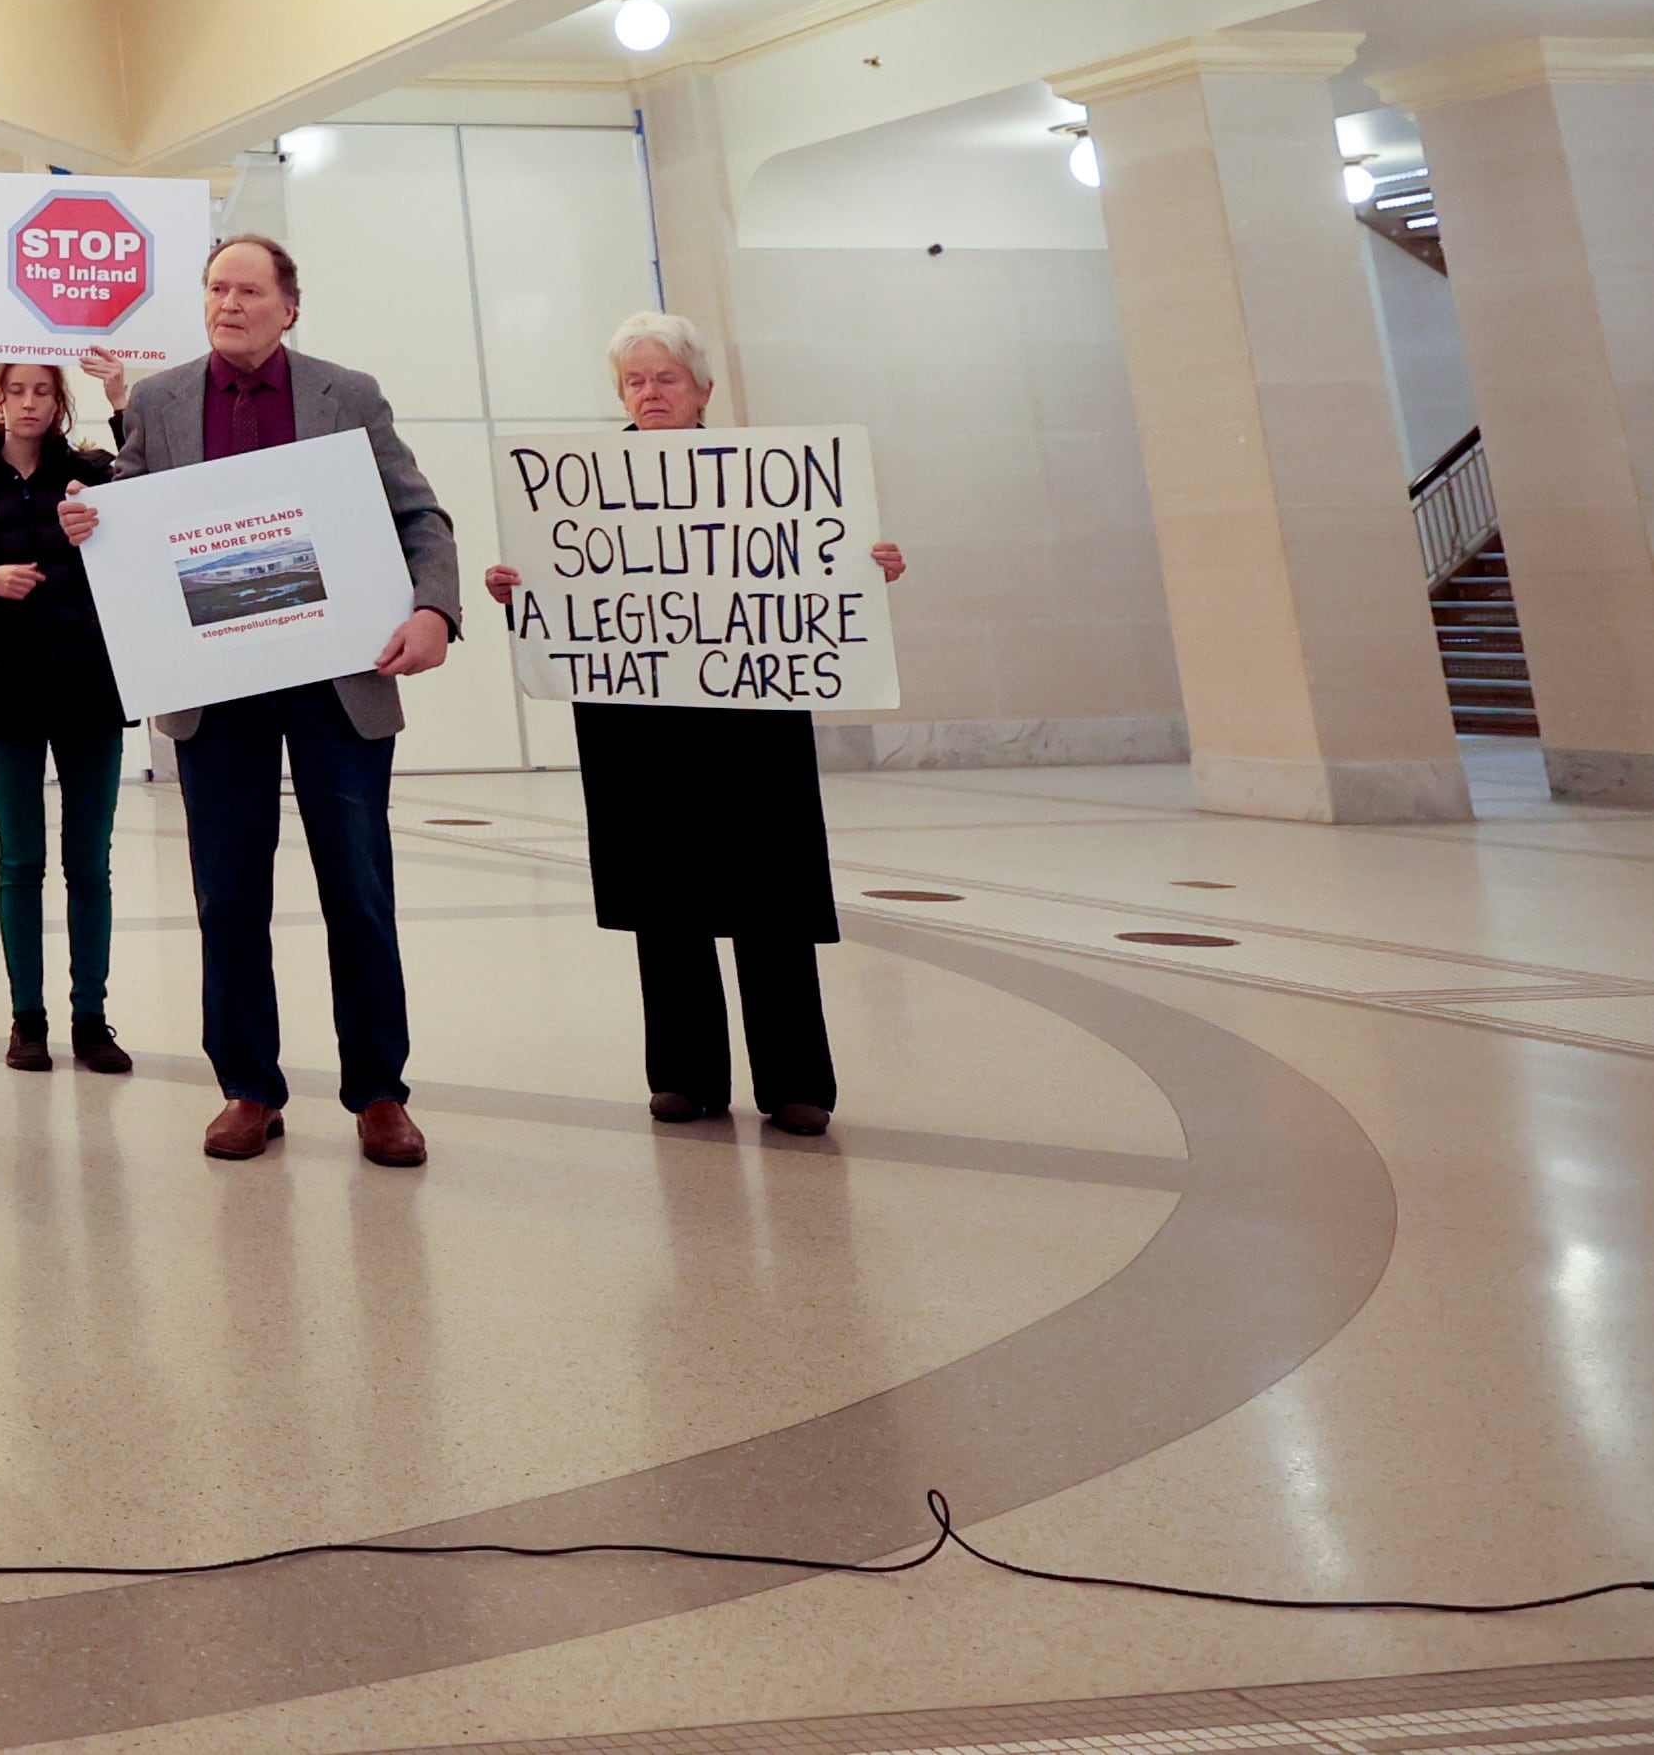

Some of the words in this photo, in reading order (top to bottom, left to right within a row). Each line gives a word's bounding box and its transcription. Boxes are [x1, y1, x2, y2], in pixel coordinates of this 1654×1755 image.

[22, 228, 140, 260] STOP
[25, 264, 61, 279] the
[69, 266, 136, 282] Inland
[52, 284, 110, 299] Ports
[511, 438, 843, 511] POLLUTION
[169, 529, 202, 543] SAVE
[205, 524, 232, 536] OUR
[235, 508, 303, 529] WETLANDS
[189, 544, 207, 555] NO
[212, 536, 247, 550] MORE
[251, 527, 292, 542] PORTS
[202, 609, 324, 638] stopthepollutingport.org
[519, 591, 550, 640] A
[566, 593, 868, 646] LEGISLATURE
[549, 651, 669, 698] THAT
[698, 650, 842, 702] CARES
